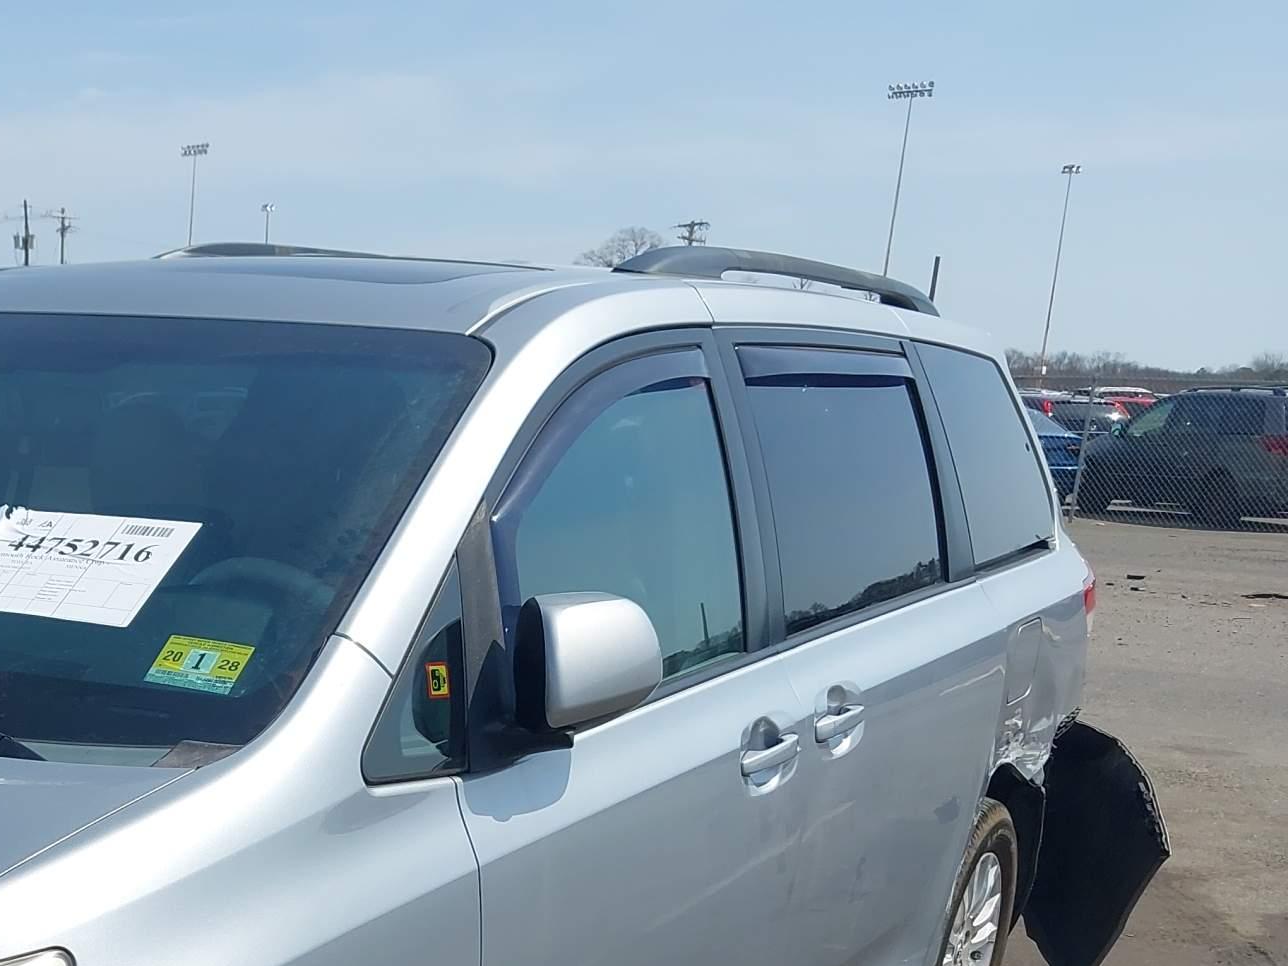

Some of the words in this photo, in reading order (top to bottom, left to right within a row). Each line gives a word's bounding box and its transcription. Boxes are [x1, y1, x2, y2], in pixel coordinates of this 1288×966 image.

[8, 534, 160, 563] 44752716
[162, 650, 184, 663] 20
[191, 652, 208, 671] 1
[217, 659, 242, 673] 28
